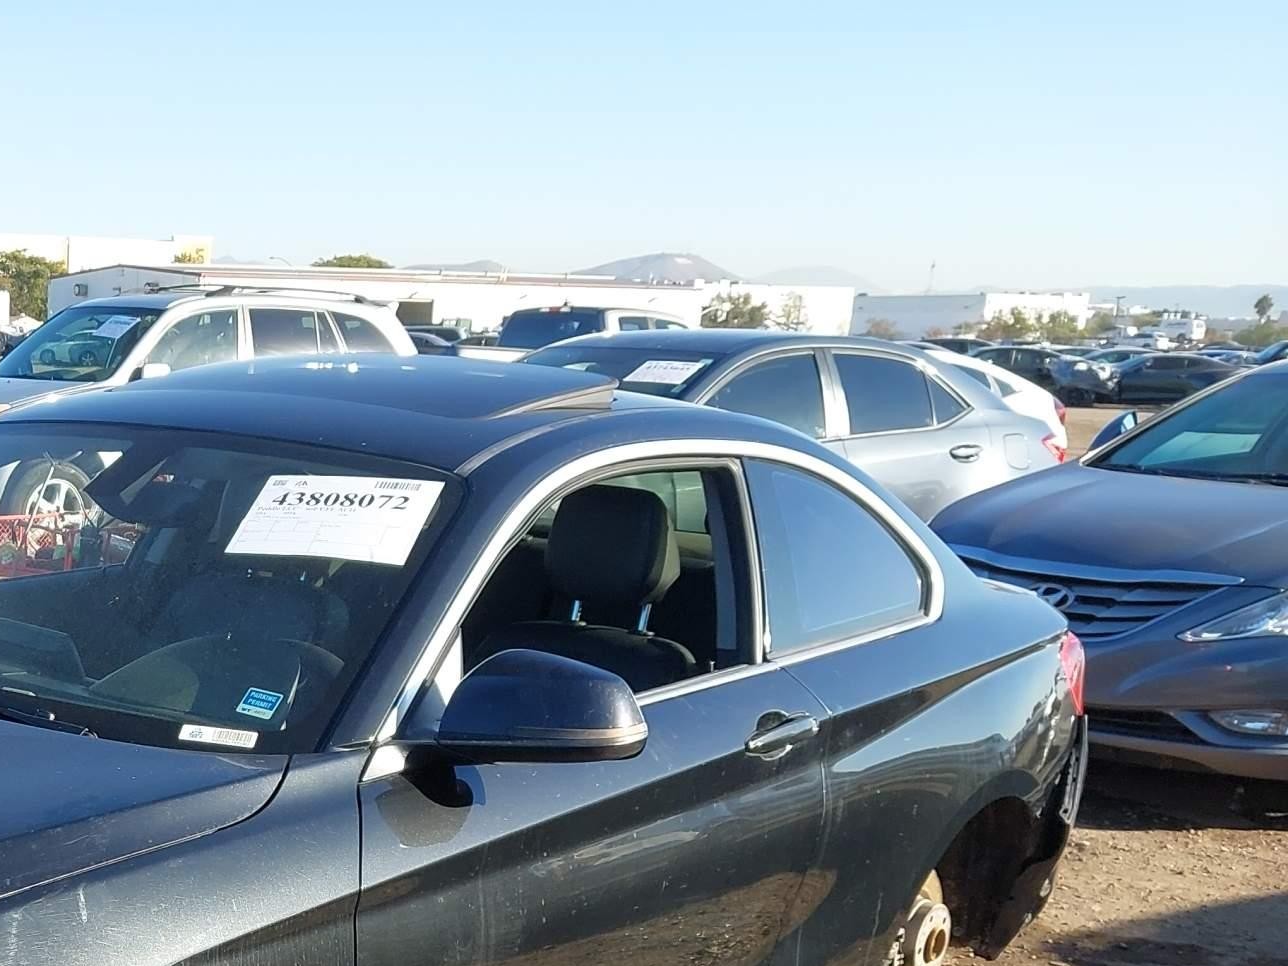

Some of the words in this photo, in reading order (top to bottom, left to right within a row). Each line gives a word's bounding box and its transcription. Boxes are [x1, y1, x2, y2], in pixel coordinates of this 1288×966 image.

[272, 491, 410, 510] 43808072
[250, 692, 278, 702] PARKING
[248, 699, 272, 709] PERMIT
